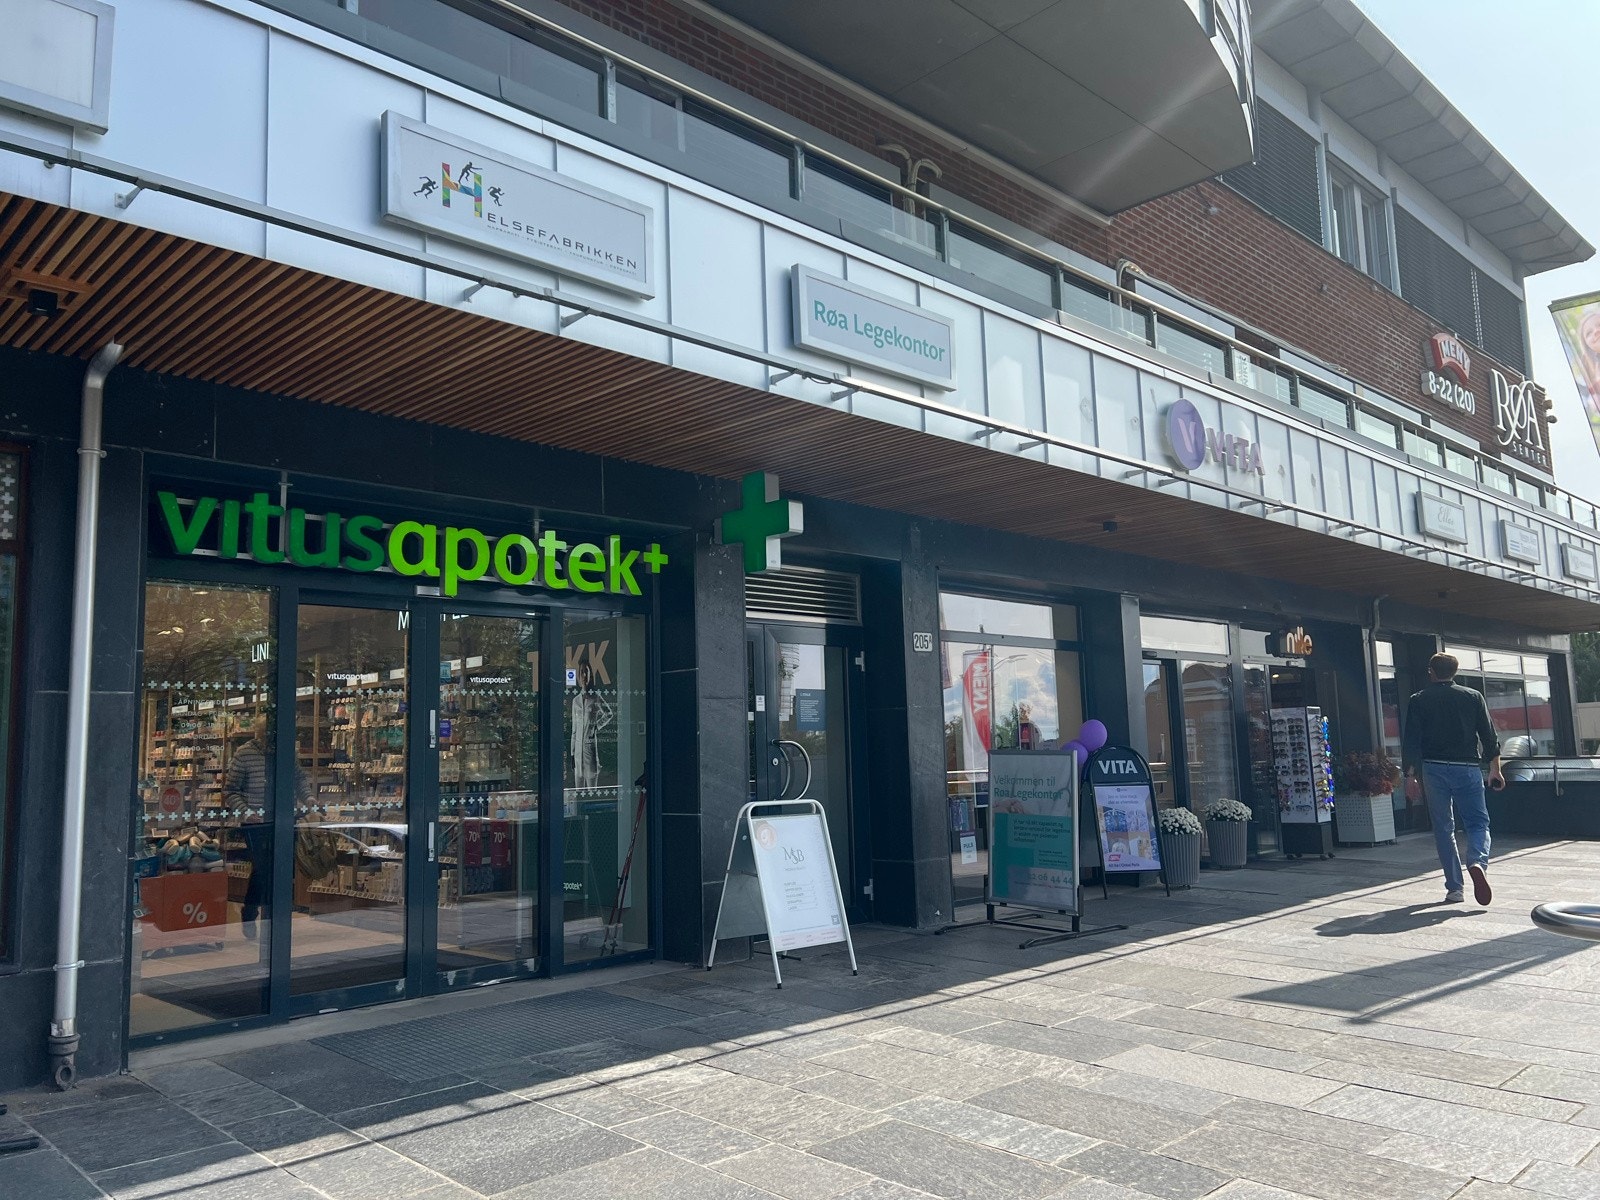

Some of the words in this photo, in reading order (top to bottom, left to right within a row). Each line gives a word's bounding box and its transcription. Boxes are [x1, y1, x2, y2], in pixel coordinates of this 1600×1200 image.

[814, 300, 848, 331] Røa
[854, 314, 945, 362] Legekontor
[1428, 371, 1453, 402] 8-22
[1454, 384, 1475, 415] (20)
[1206, 427, 1266, 476] VITA
[993, 774, 1044, 787] Velkommen
[1046, 775, 1056, 788] til
[1098, 759, 1139, 775] VITA
